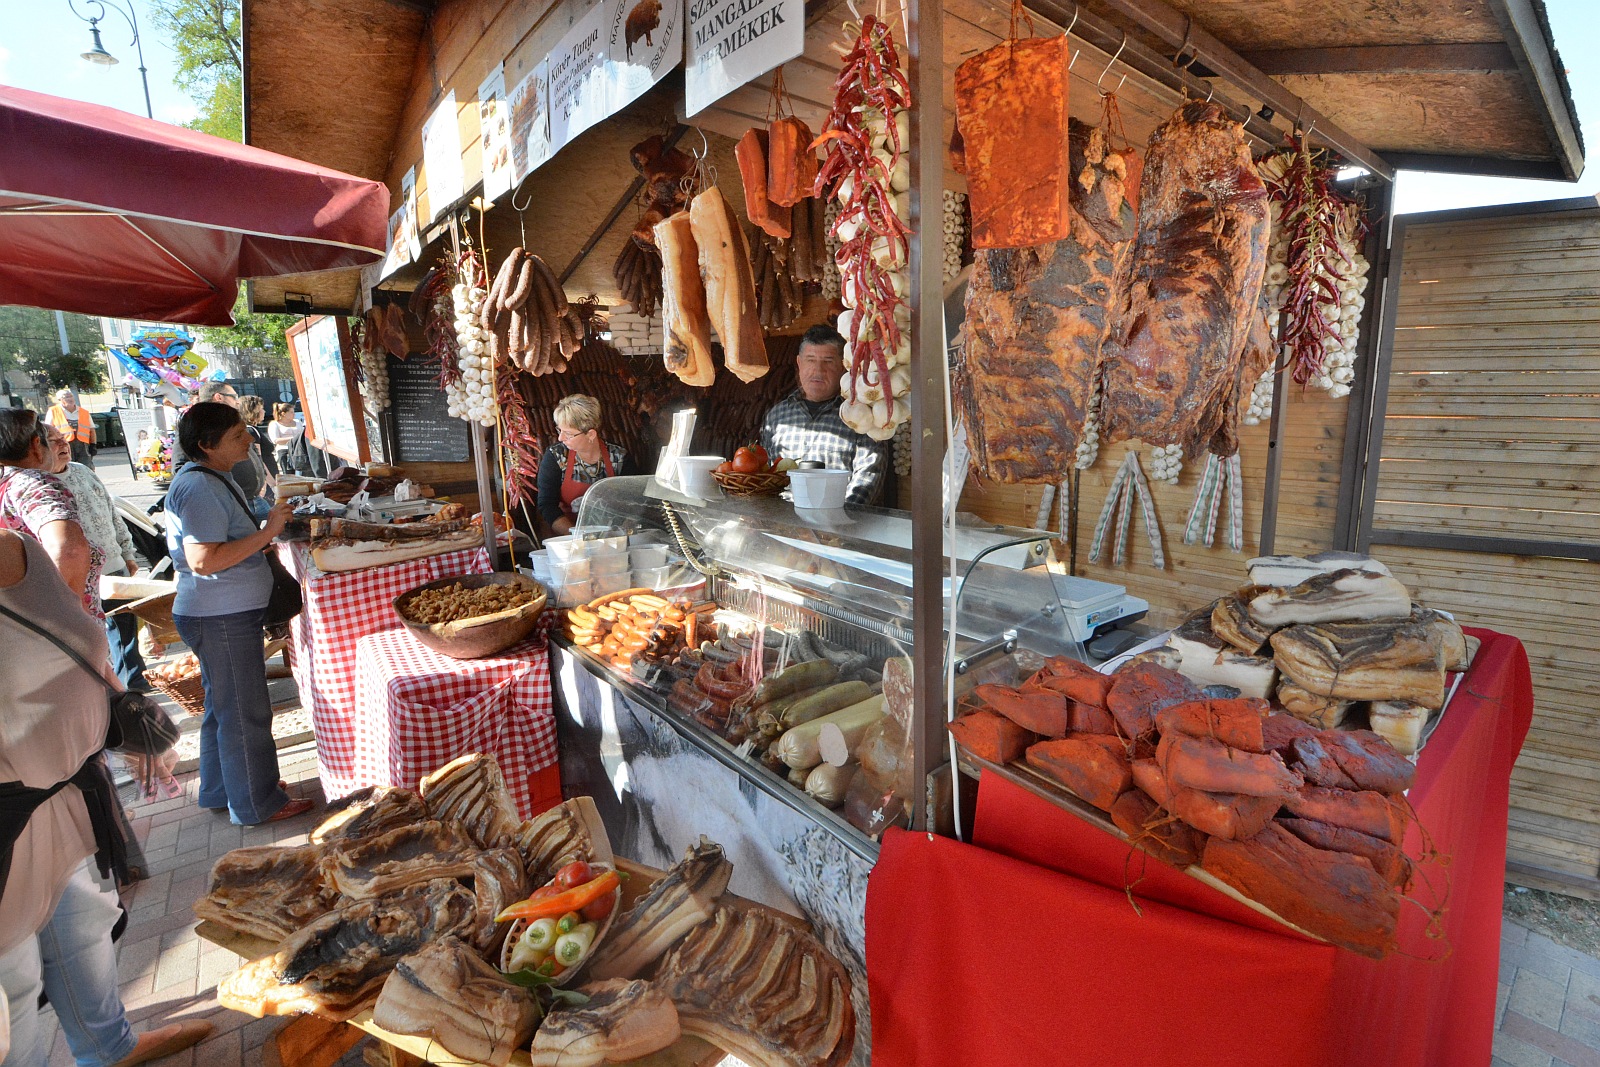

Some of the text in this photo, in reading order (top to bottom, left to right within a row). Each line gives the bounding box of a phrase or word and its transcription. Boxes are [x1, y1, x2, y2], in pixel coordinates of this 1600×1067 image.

[690, 0, 718, 25] SZA
[572, 28, 598, 61] Tanya
[697, 1, 785, 75] TERMÉKEK
